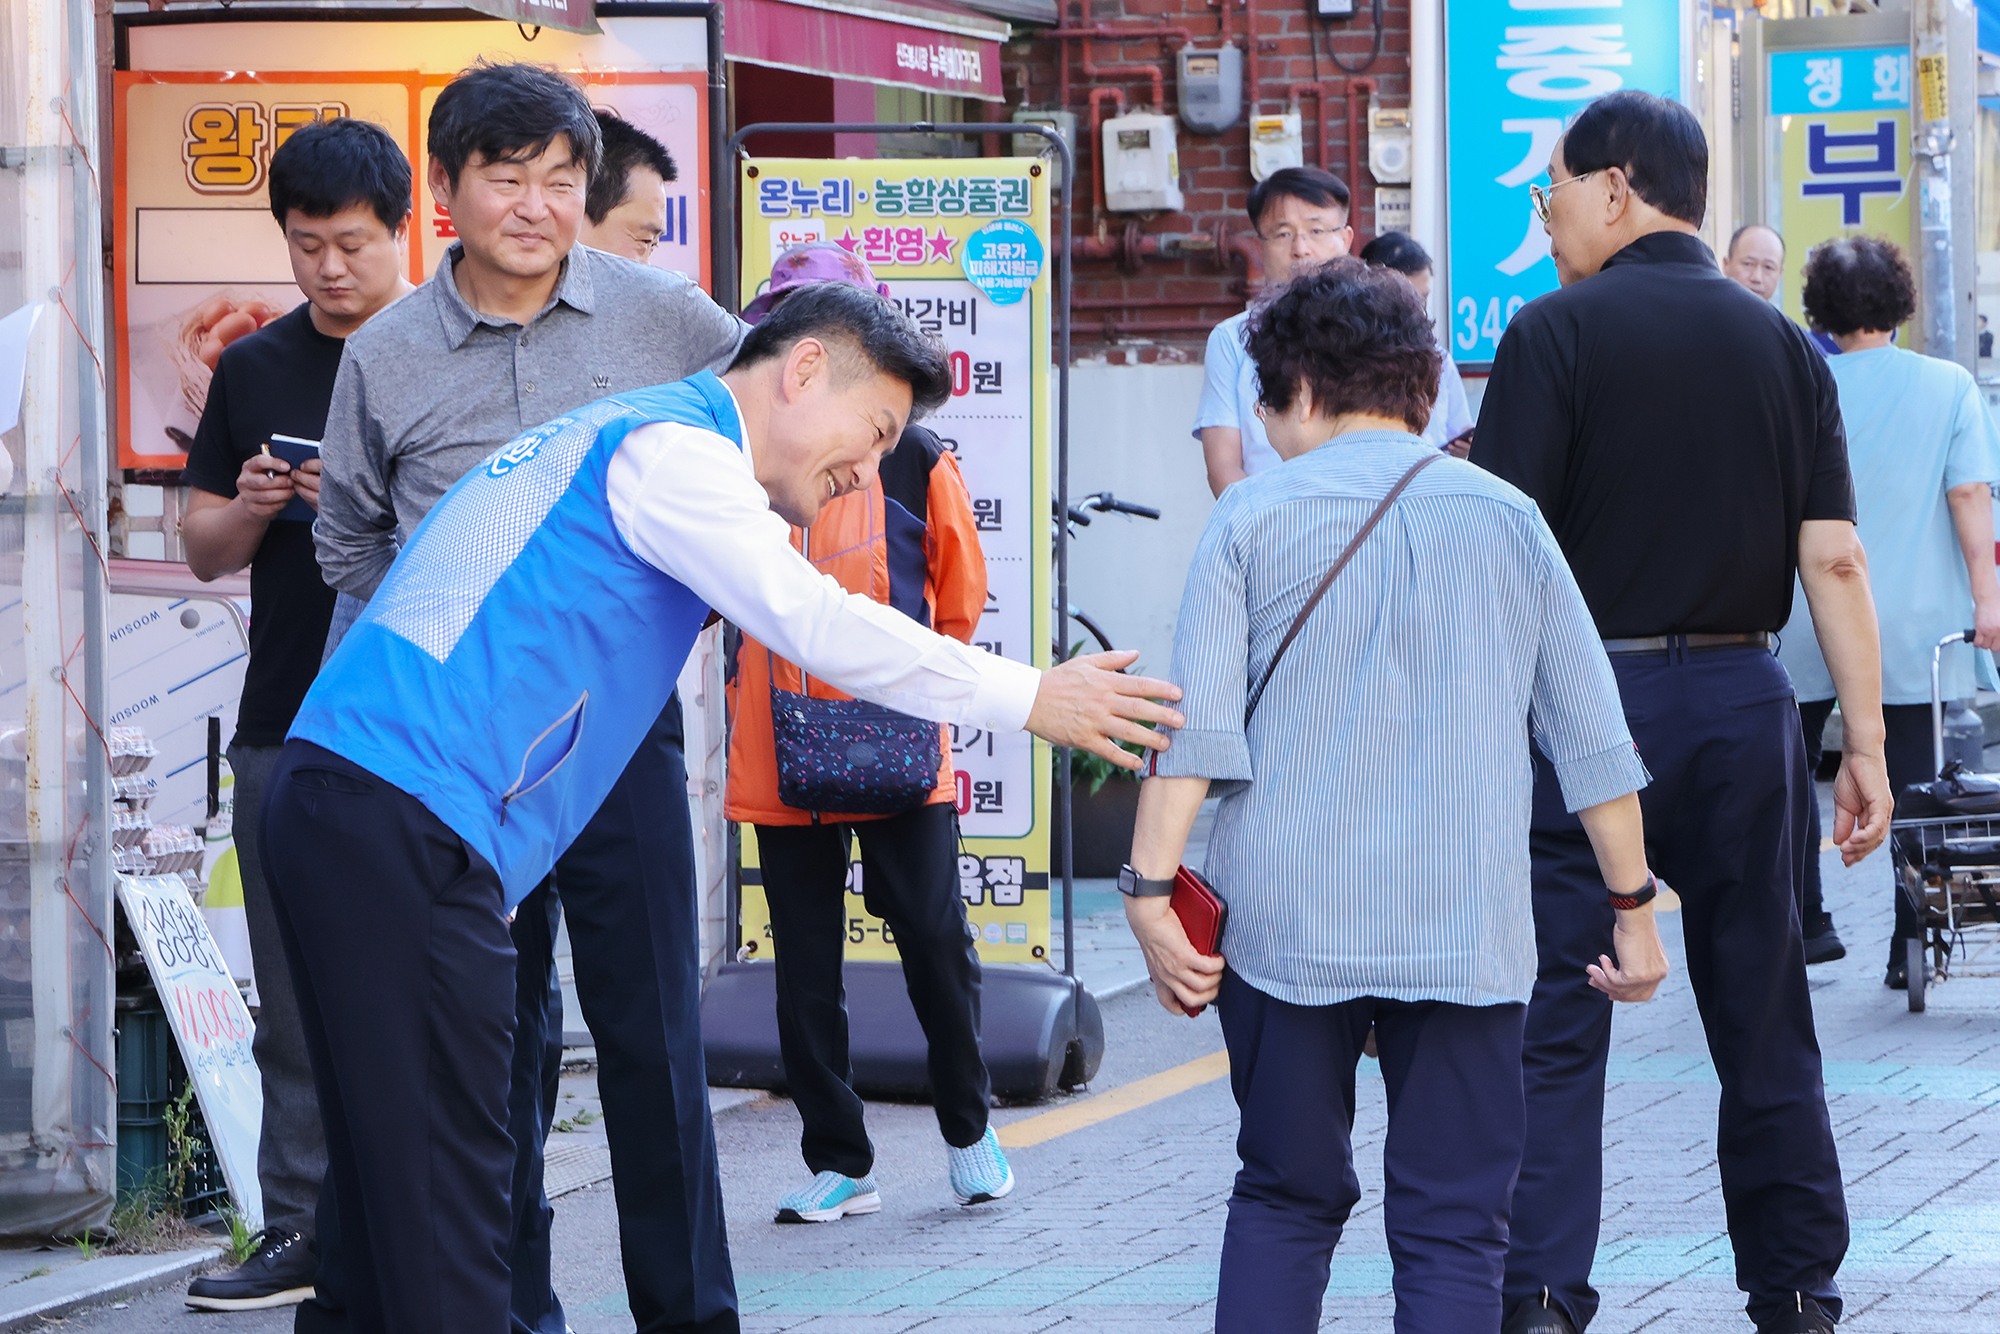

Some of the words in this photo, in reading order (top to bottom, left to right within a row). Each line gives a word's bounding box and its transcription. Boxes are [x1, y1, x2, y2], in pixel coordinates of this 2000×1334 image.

[862, 226, 924, 264] 환영
[981, 243, 1027, 260] 고유가
[970, 260, 1038, 276] 피해지원금
[110, 611, 160, 642] WOOSUN
[110, 695, 159, 726] WOOSUN
[175, 983, 247, 1050] 11,000
